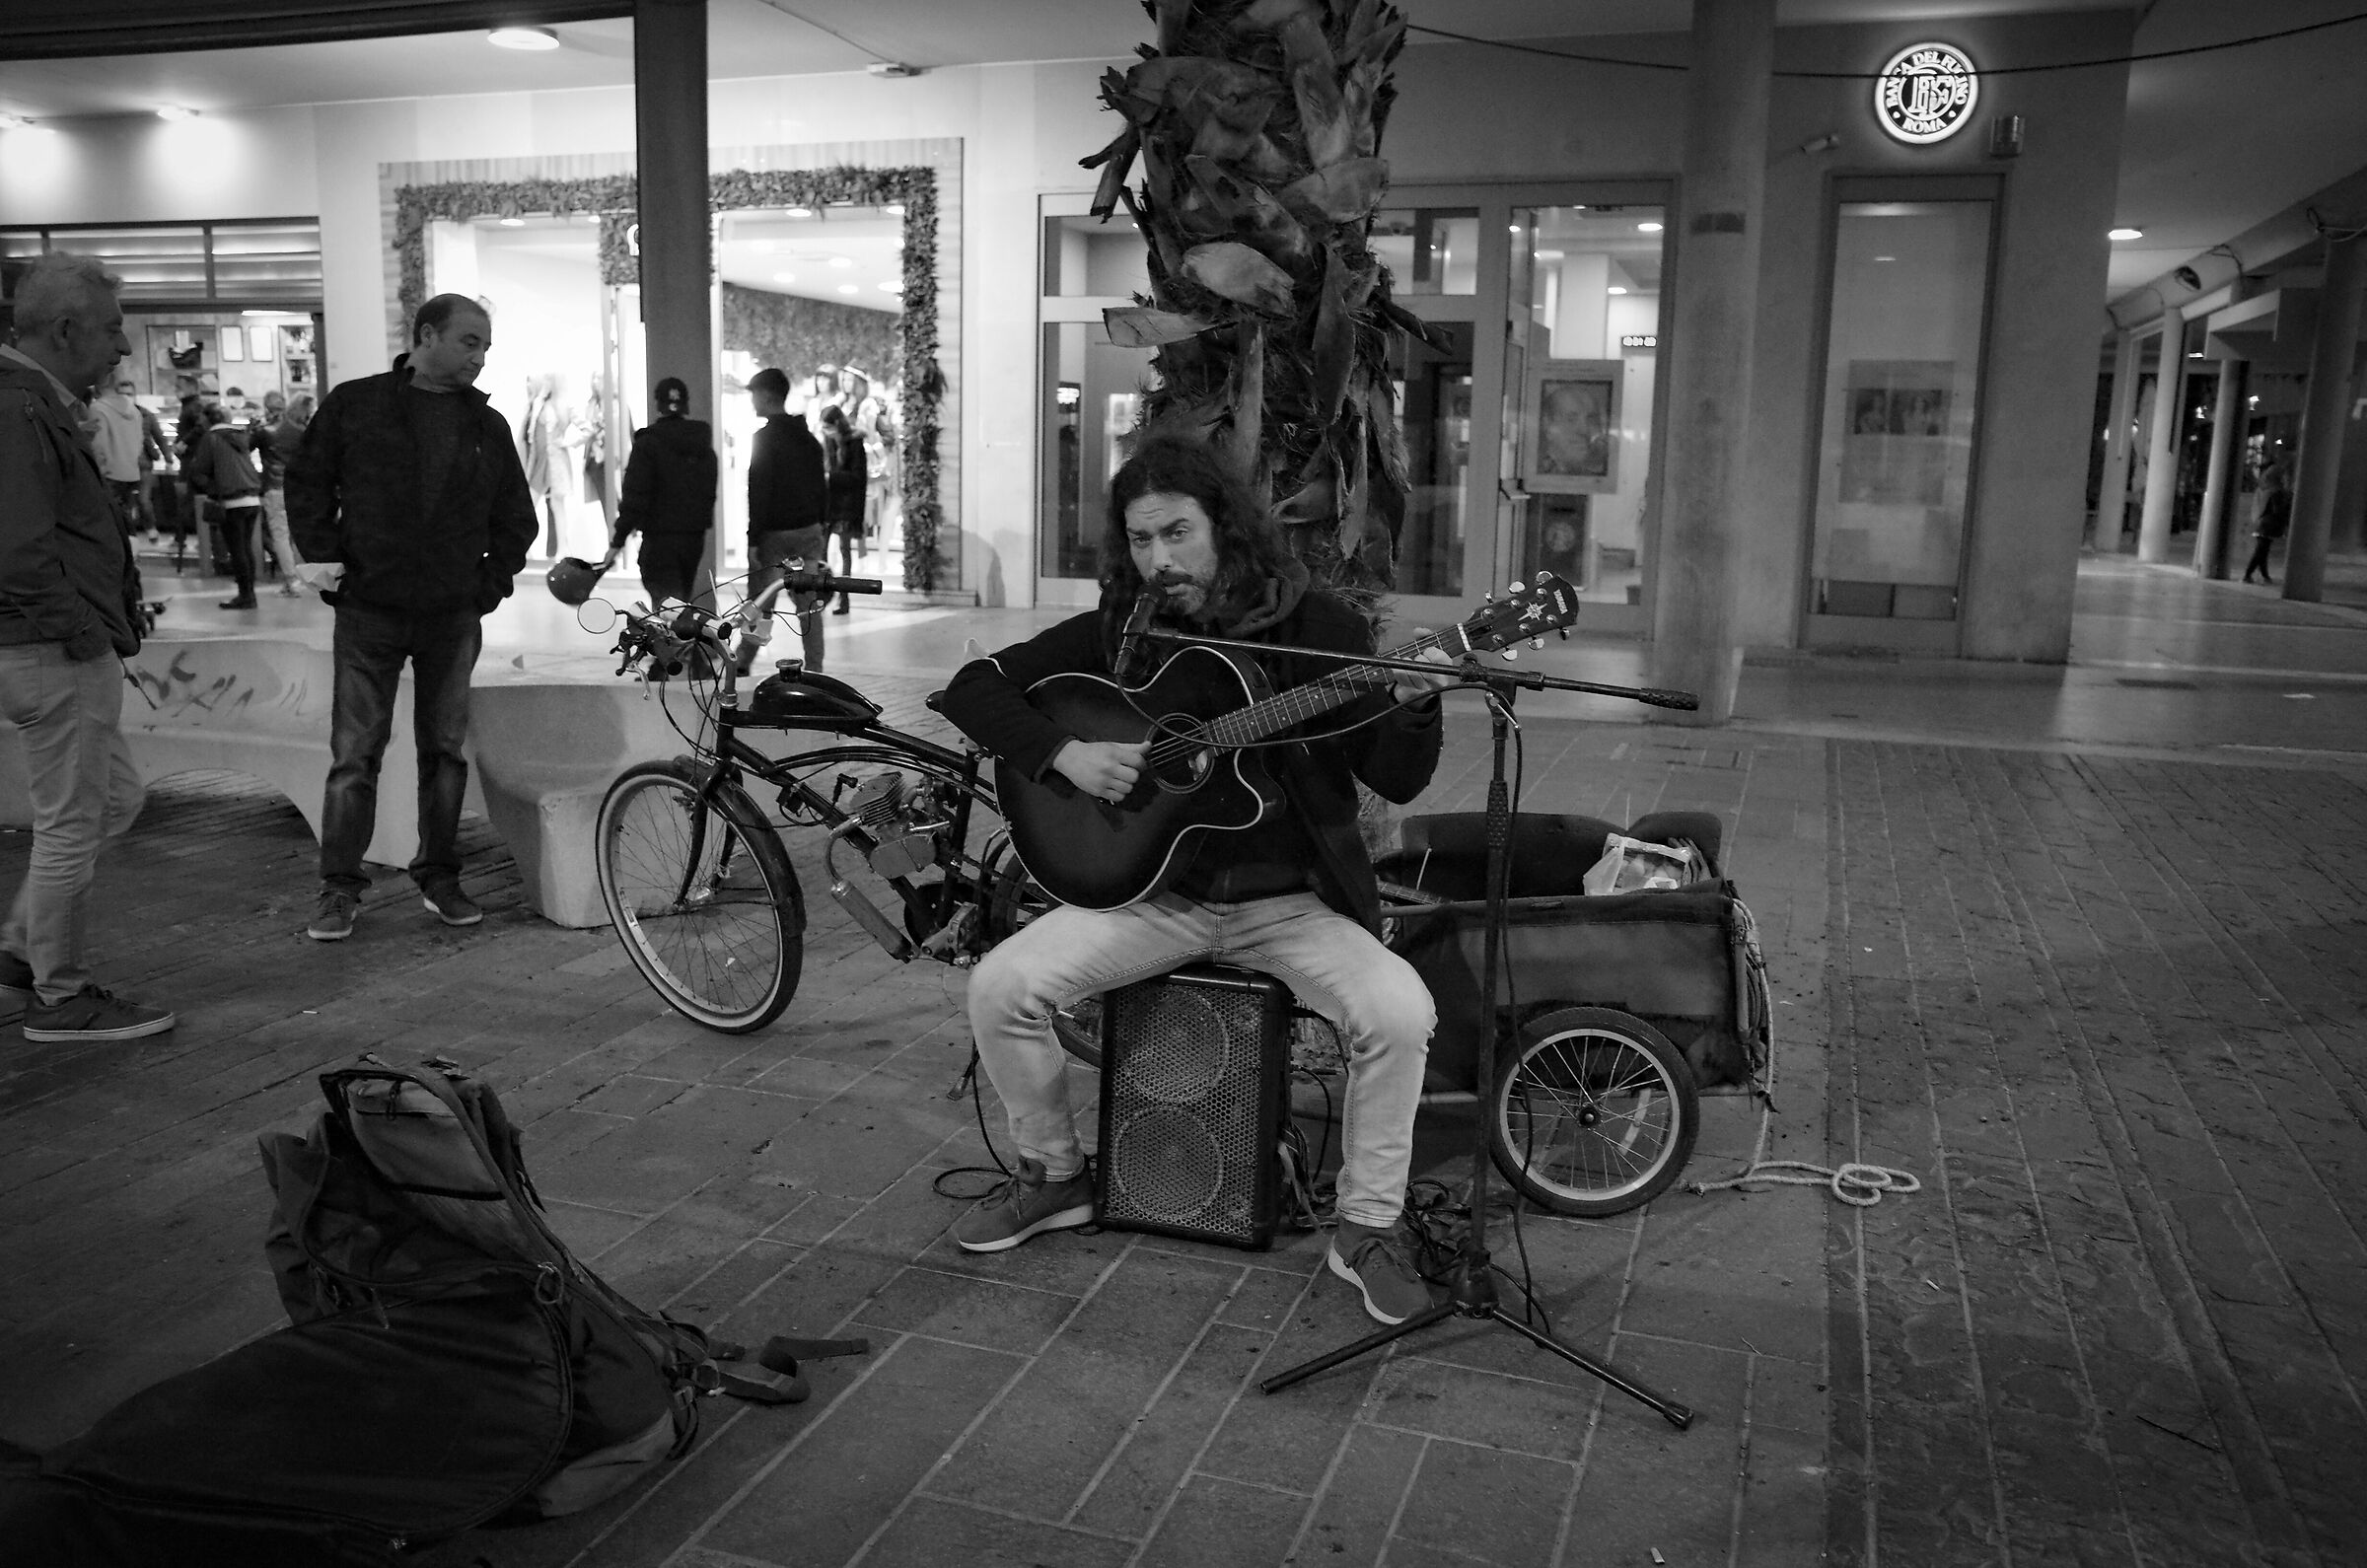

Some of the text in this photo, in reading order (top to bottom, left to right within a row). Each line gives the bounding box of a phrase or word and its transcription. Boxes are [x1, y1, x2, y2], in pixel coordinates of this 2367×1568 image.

[1912, 50, 1941, 66] DEL
[1902, 117, 1948, 133] ROMA
[1553, 589, 1568, 614] YAMAHA
